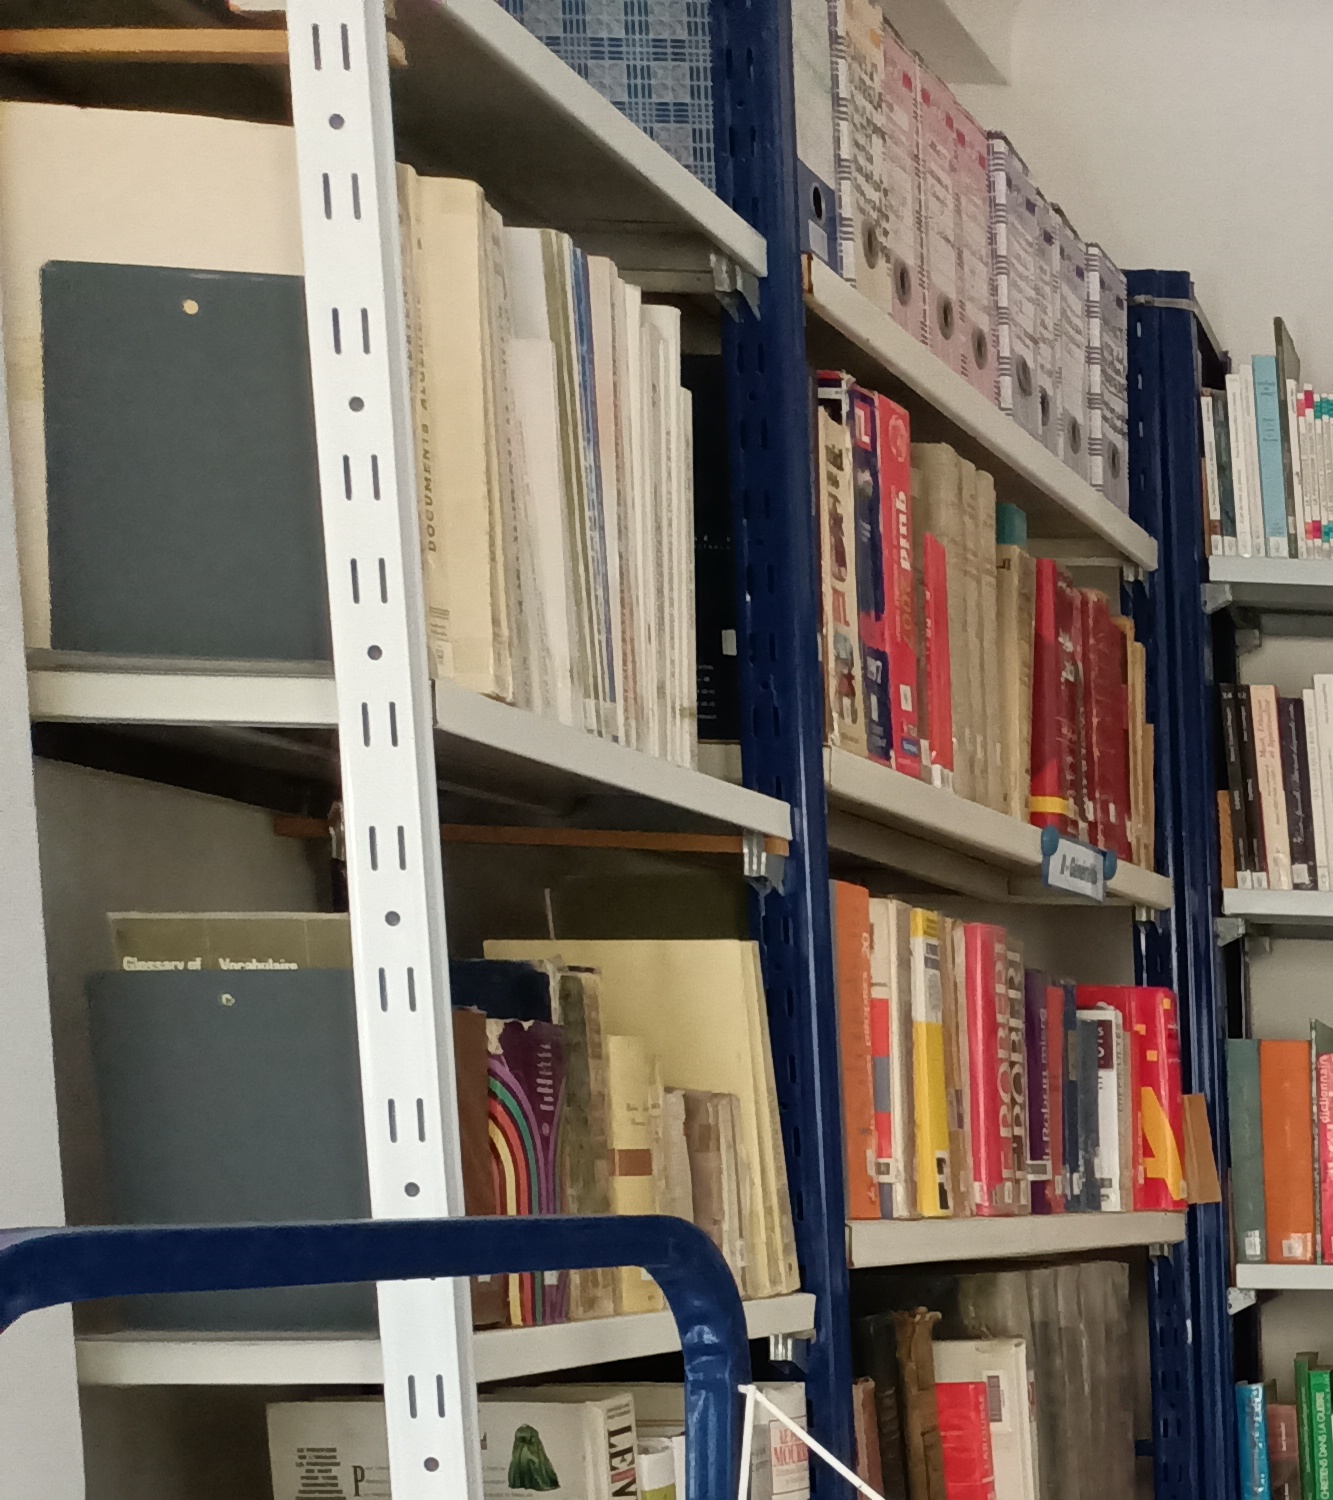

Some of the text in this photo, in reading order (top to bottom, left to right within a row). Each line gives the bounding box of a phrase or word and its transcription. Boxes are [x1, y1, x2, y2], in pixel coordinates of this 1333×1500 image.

[421, 424, 437, 552] DOCUMENTS
[123, 956, 184, 971] Glossary
[1318, 1423, 1326, 1433] LA
[1318, 1436, 1328, 1457] DANS
